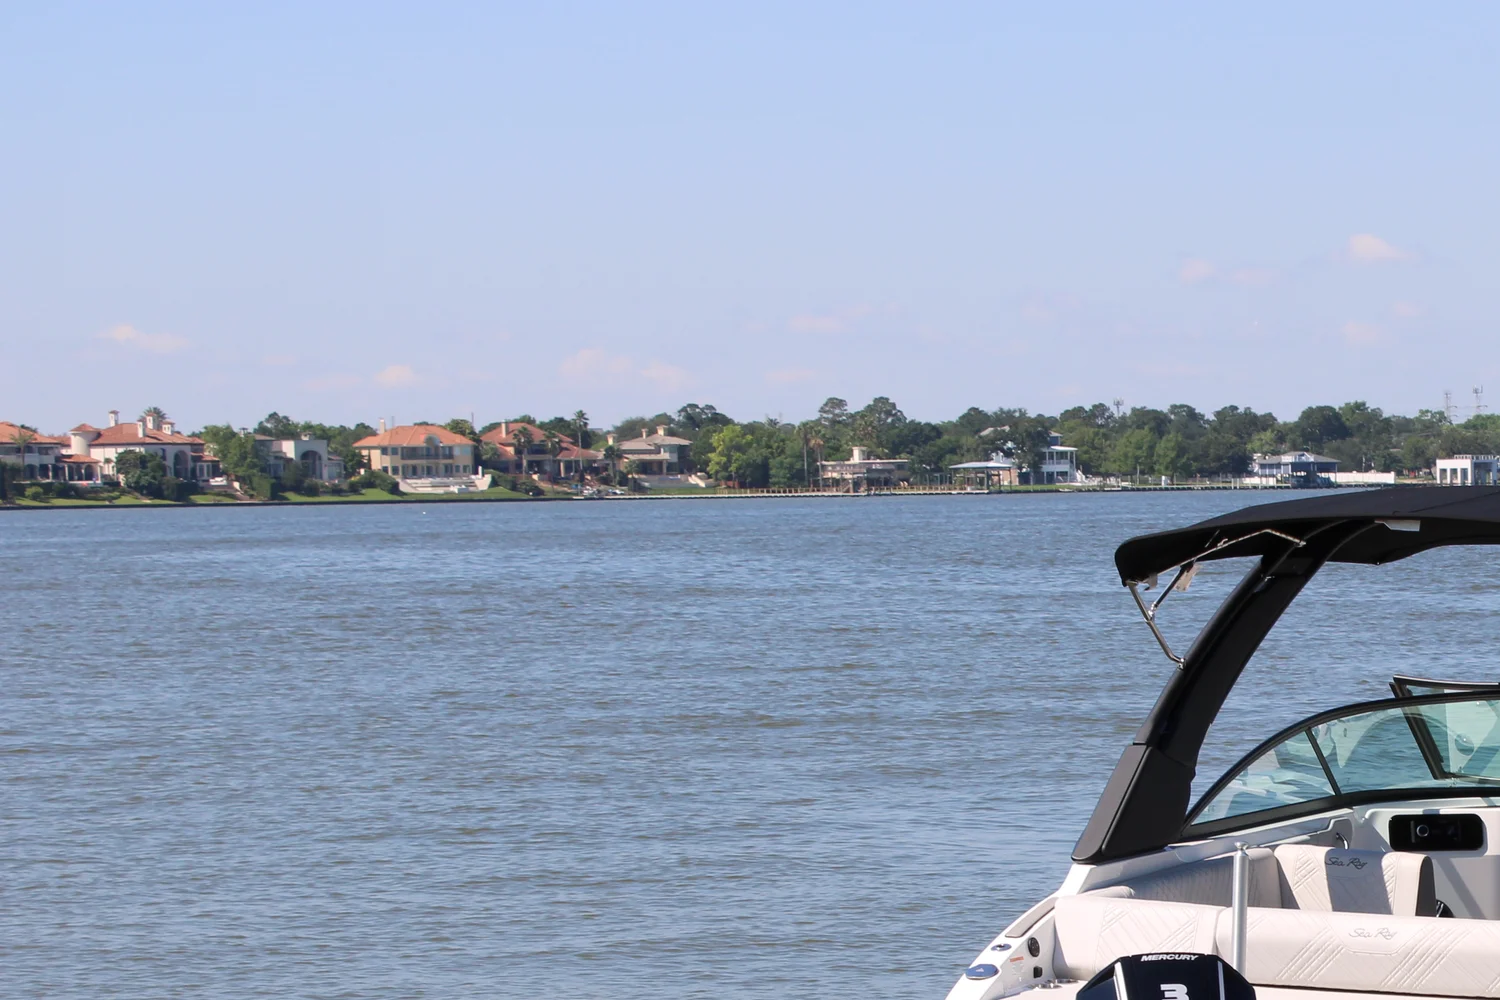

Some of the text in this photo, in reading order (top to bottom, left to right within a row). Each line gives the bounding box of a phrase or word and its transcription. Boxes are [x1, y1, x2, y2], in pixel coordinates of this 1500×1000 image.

[1325, 857, 1368, 870] Sea Ray
[1140, 954, 1199, 962] MERCURY
